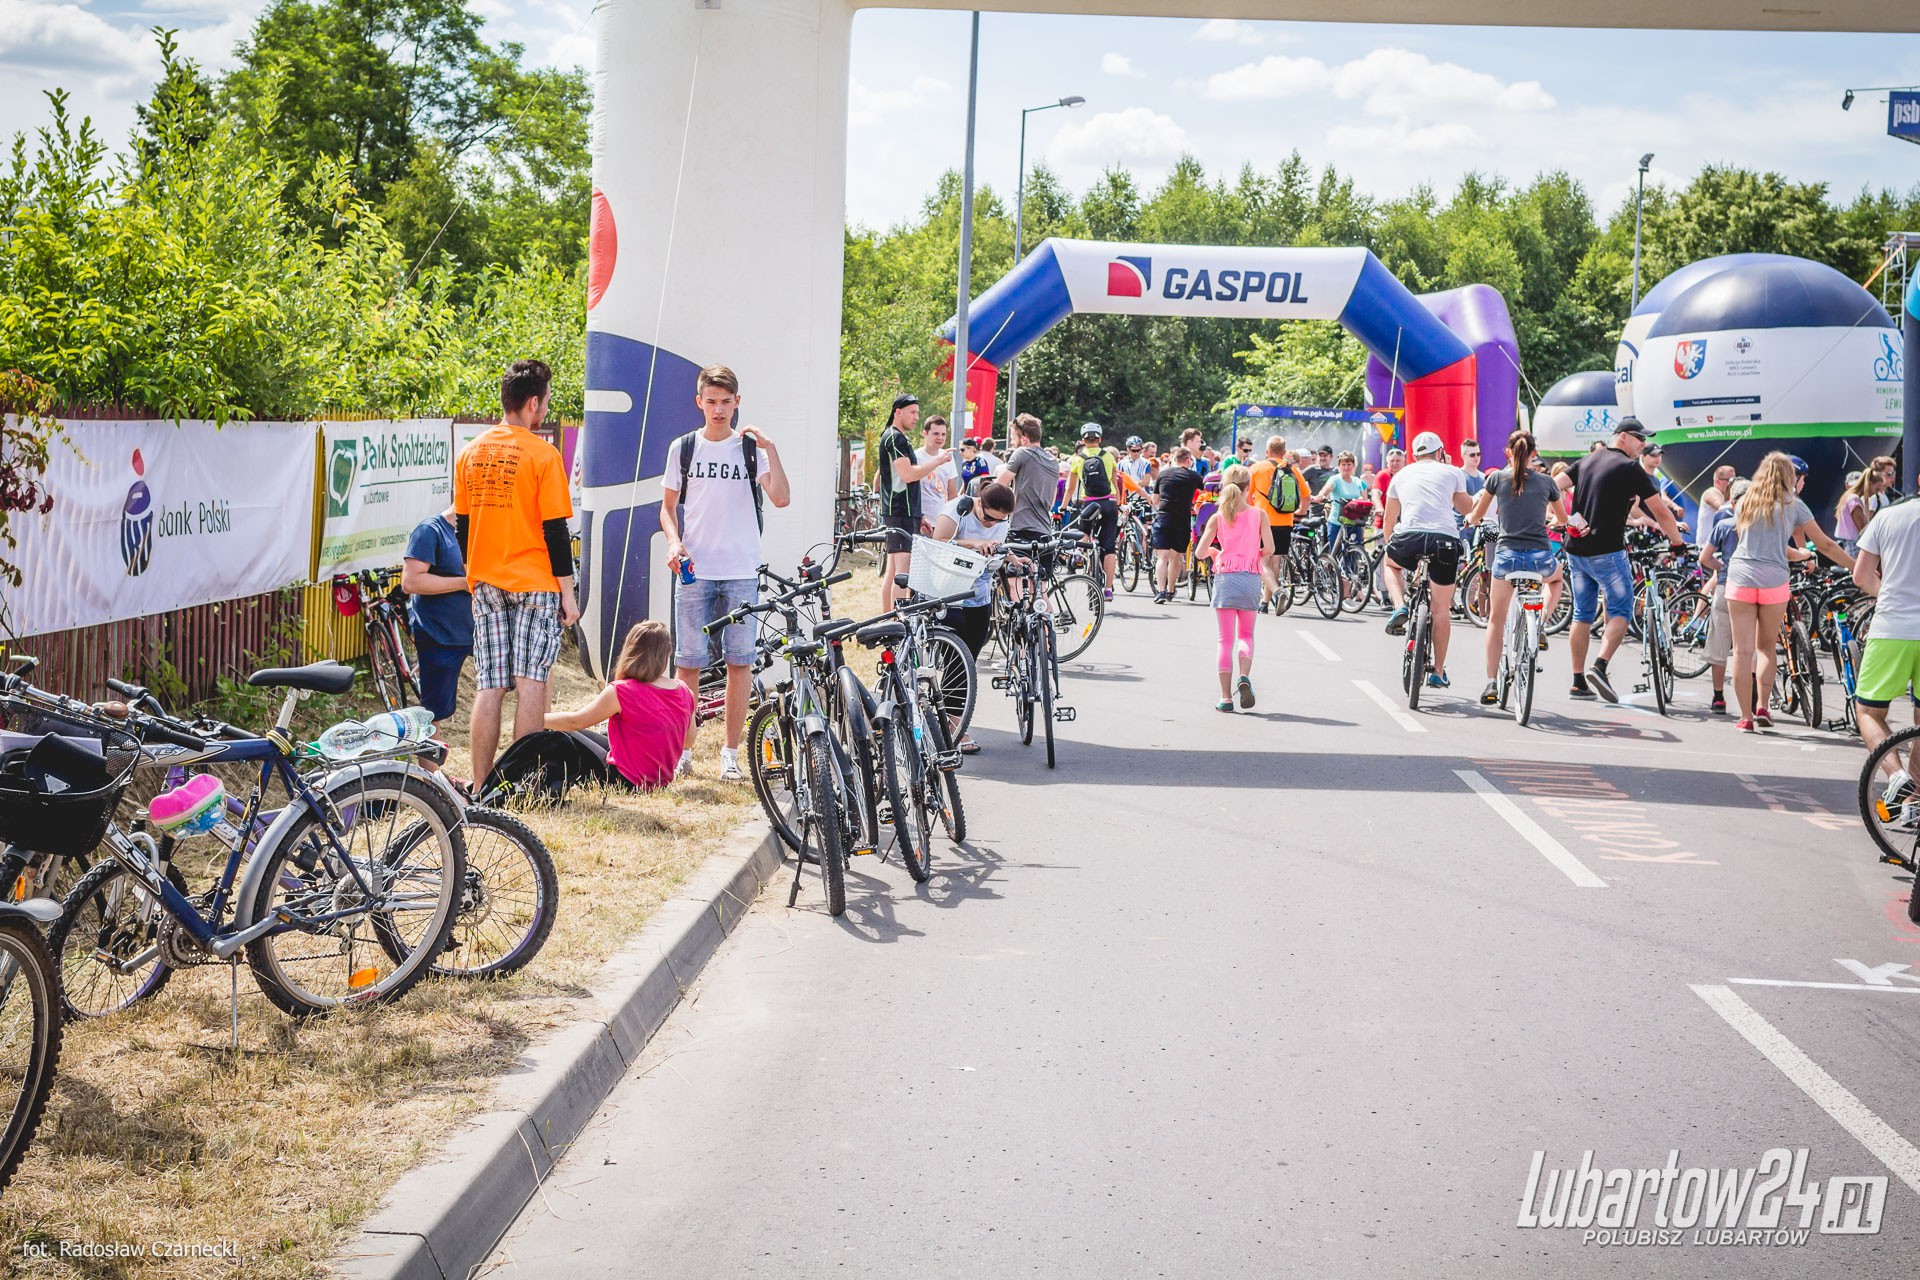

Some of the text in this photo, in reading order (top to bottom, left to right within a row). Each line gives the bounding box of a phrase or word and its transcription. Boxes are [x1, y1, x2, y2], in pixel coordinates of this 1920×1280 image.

[1893, 100, 1920, 127] psb
[1163, 268, 1308, 303] GASPOL
[1293, 409, 1343, 418] www.pgk.lub.pl
[1686, 428, 1752, 439] www.lubartow.pl
[390, 433, 450, 476] Spółdzielczy
[159, 499, 230, 537] Bank Polski
